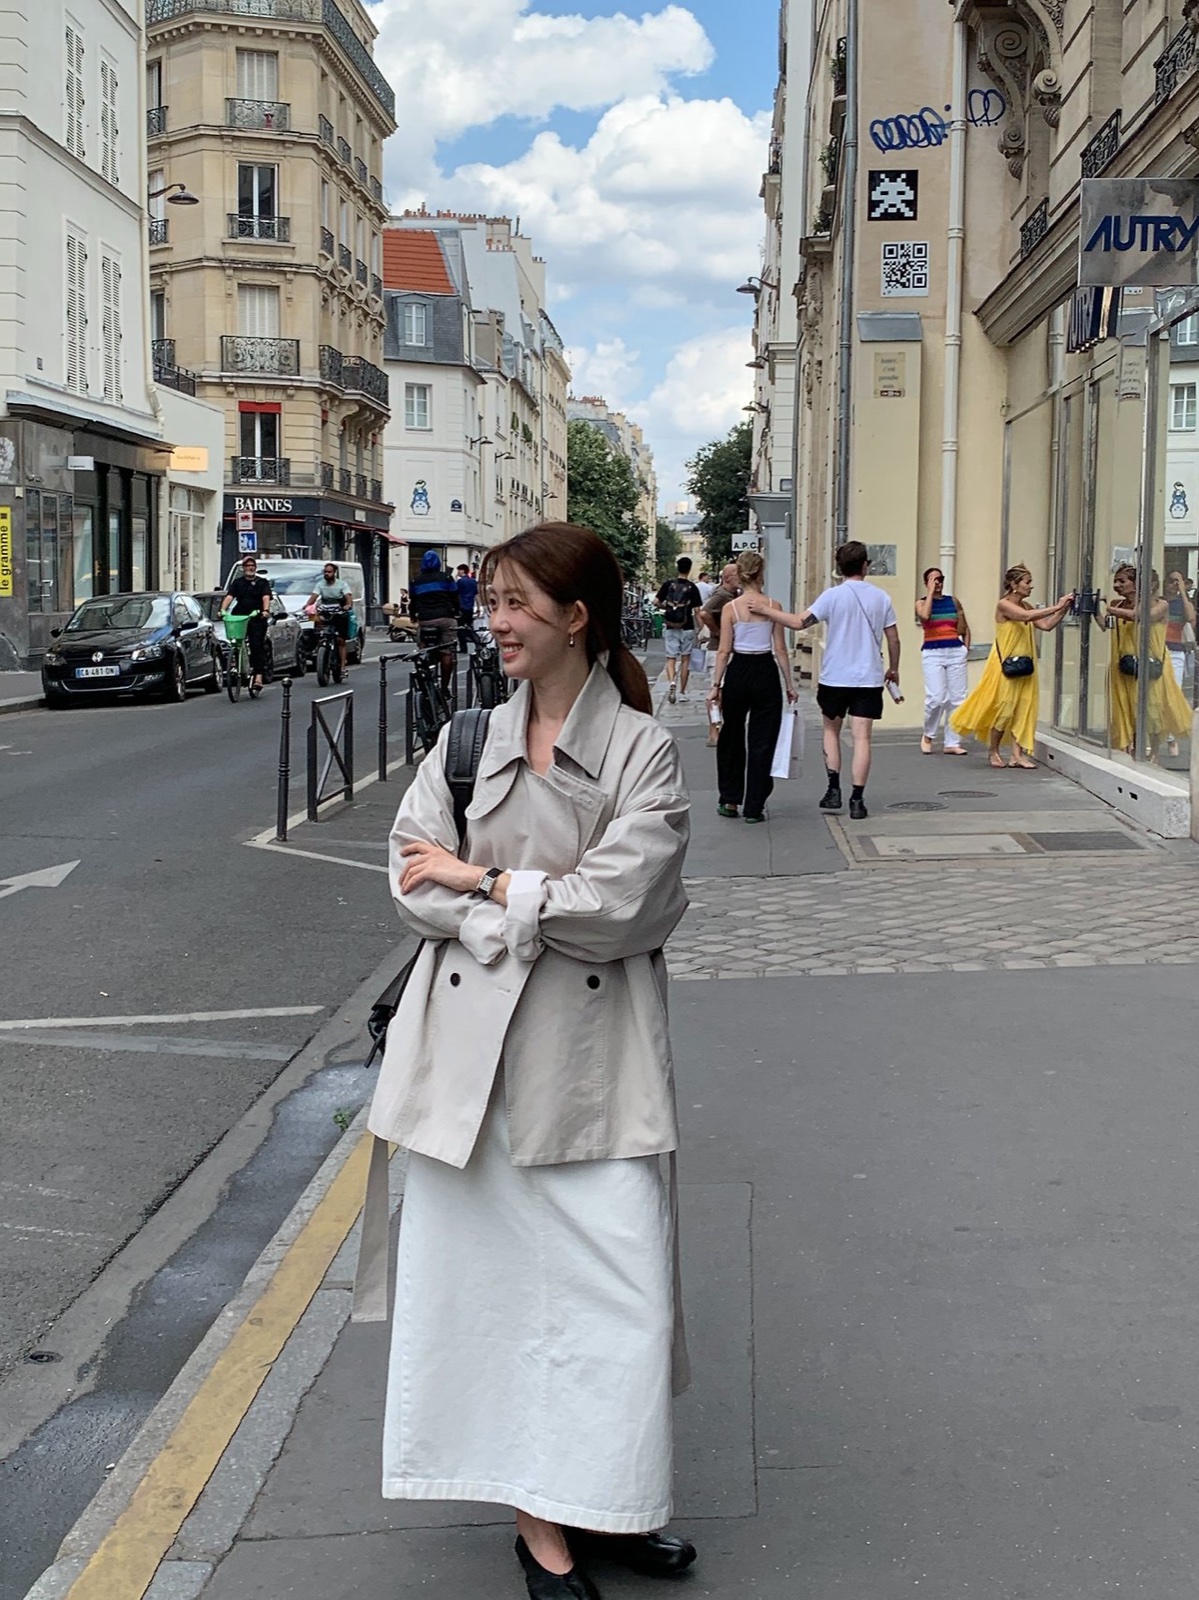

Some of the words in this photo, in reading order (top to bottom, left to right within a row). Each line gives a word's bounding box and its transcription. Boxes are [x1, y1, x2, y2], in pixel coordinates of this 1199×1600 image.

[1084, 215, 1199, 252] AUTRY
[234, 497, 292, 512] BARNES
[1, 525, 11, 576] gramme
[0, 579, 9, 590] le
